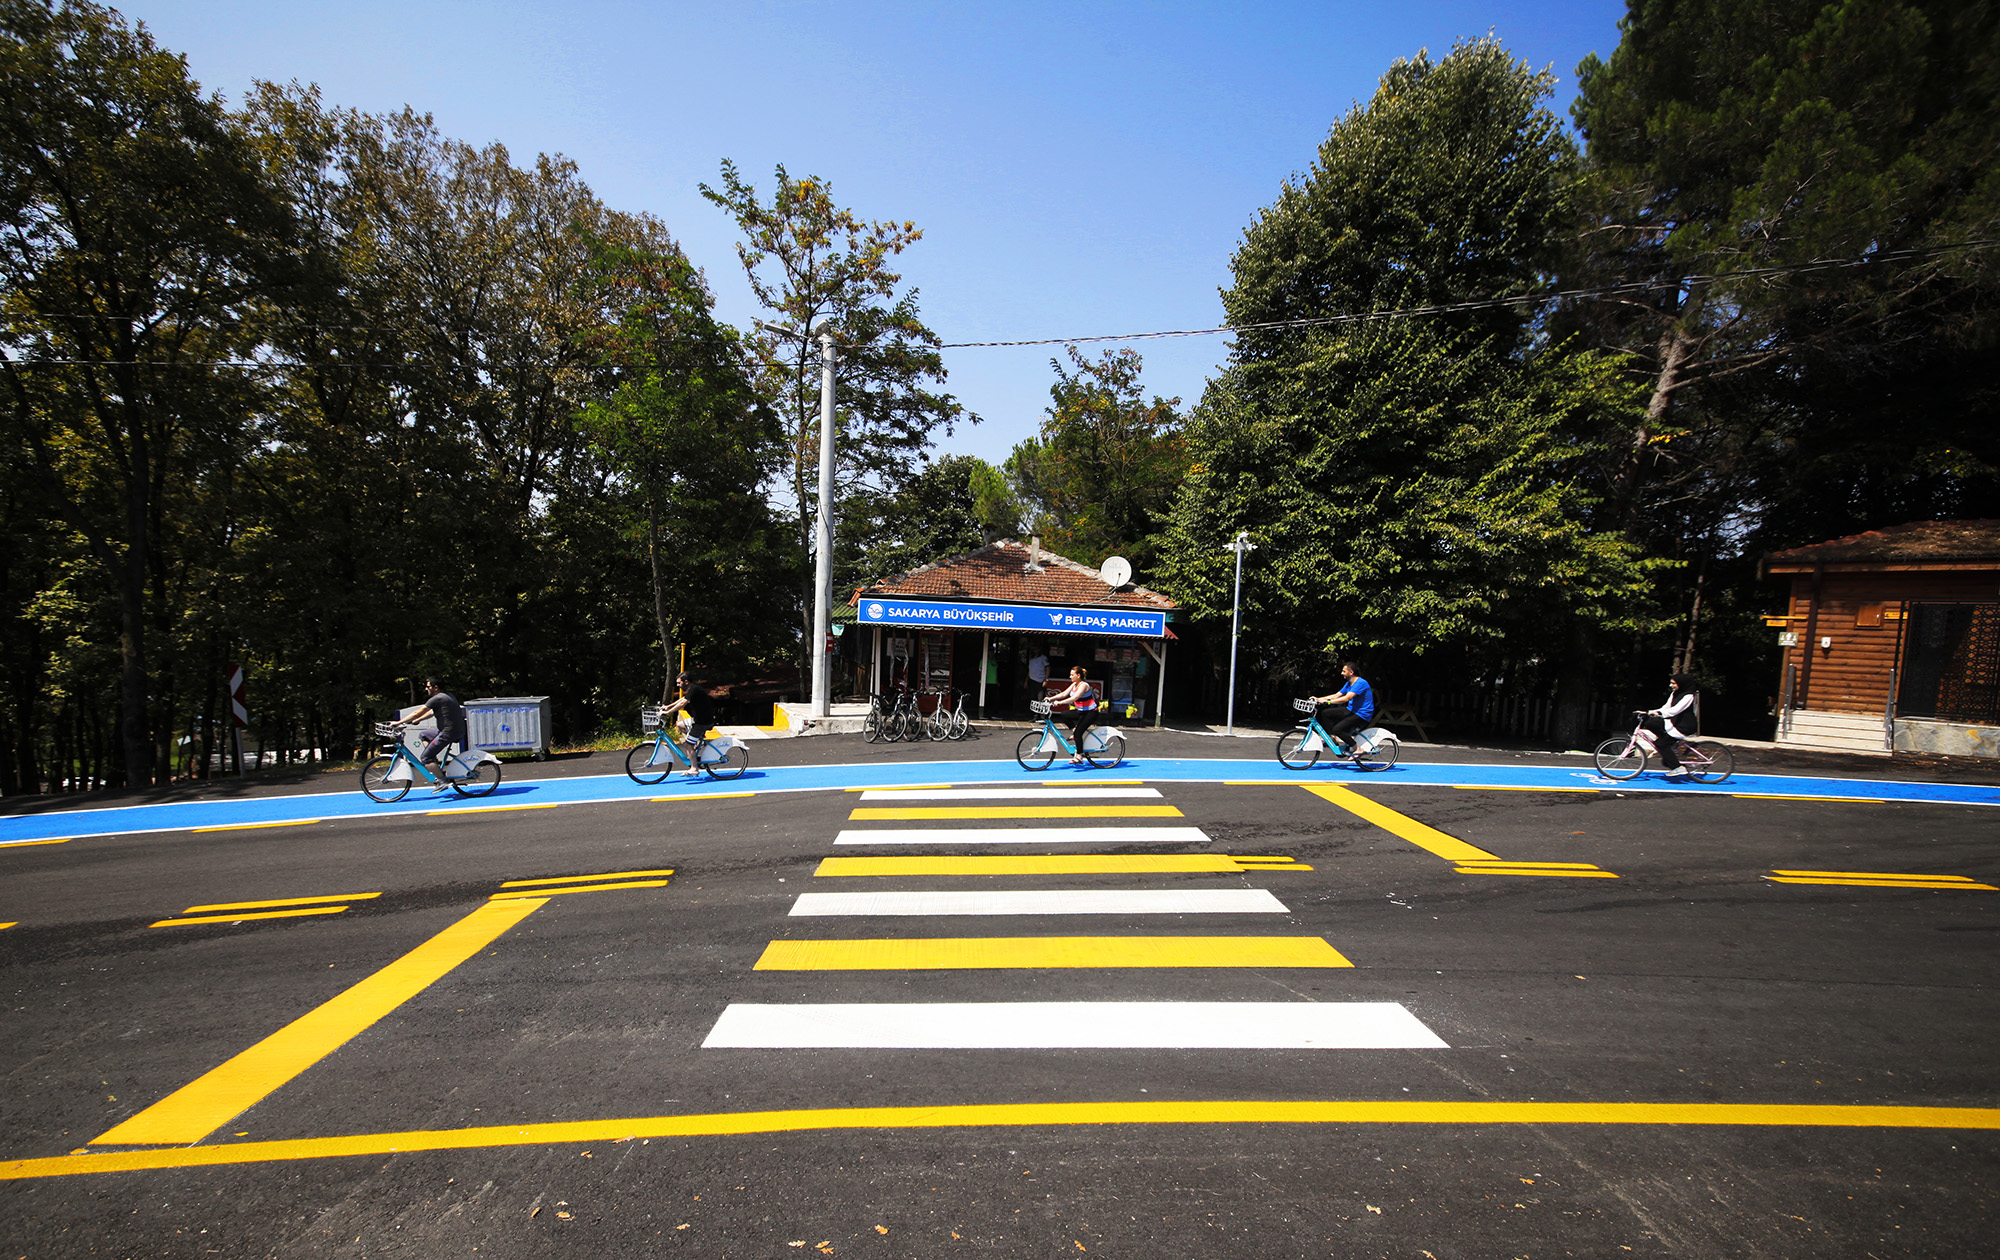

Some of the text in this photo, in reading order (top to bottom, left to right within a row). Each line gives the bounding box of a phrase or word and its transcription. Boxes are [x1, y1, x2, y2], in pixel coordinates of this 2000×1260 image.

[888, 607, 1014, 623] SAKARYA BÜYÜKŞEHİR
[1065, 615, 1157, 629] BELPAŞ MARKET
